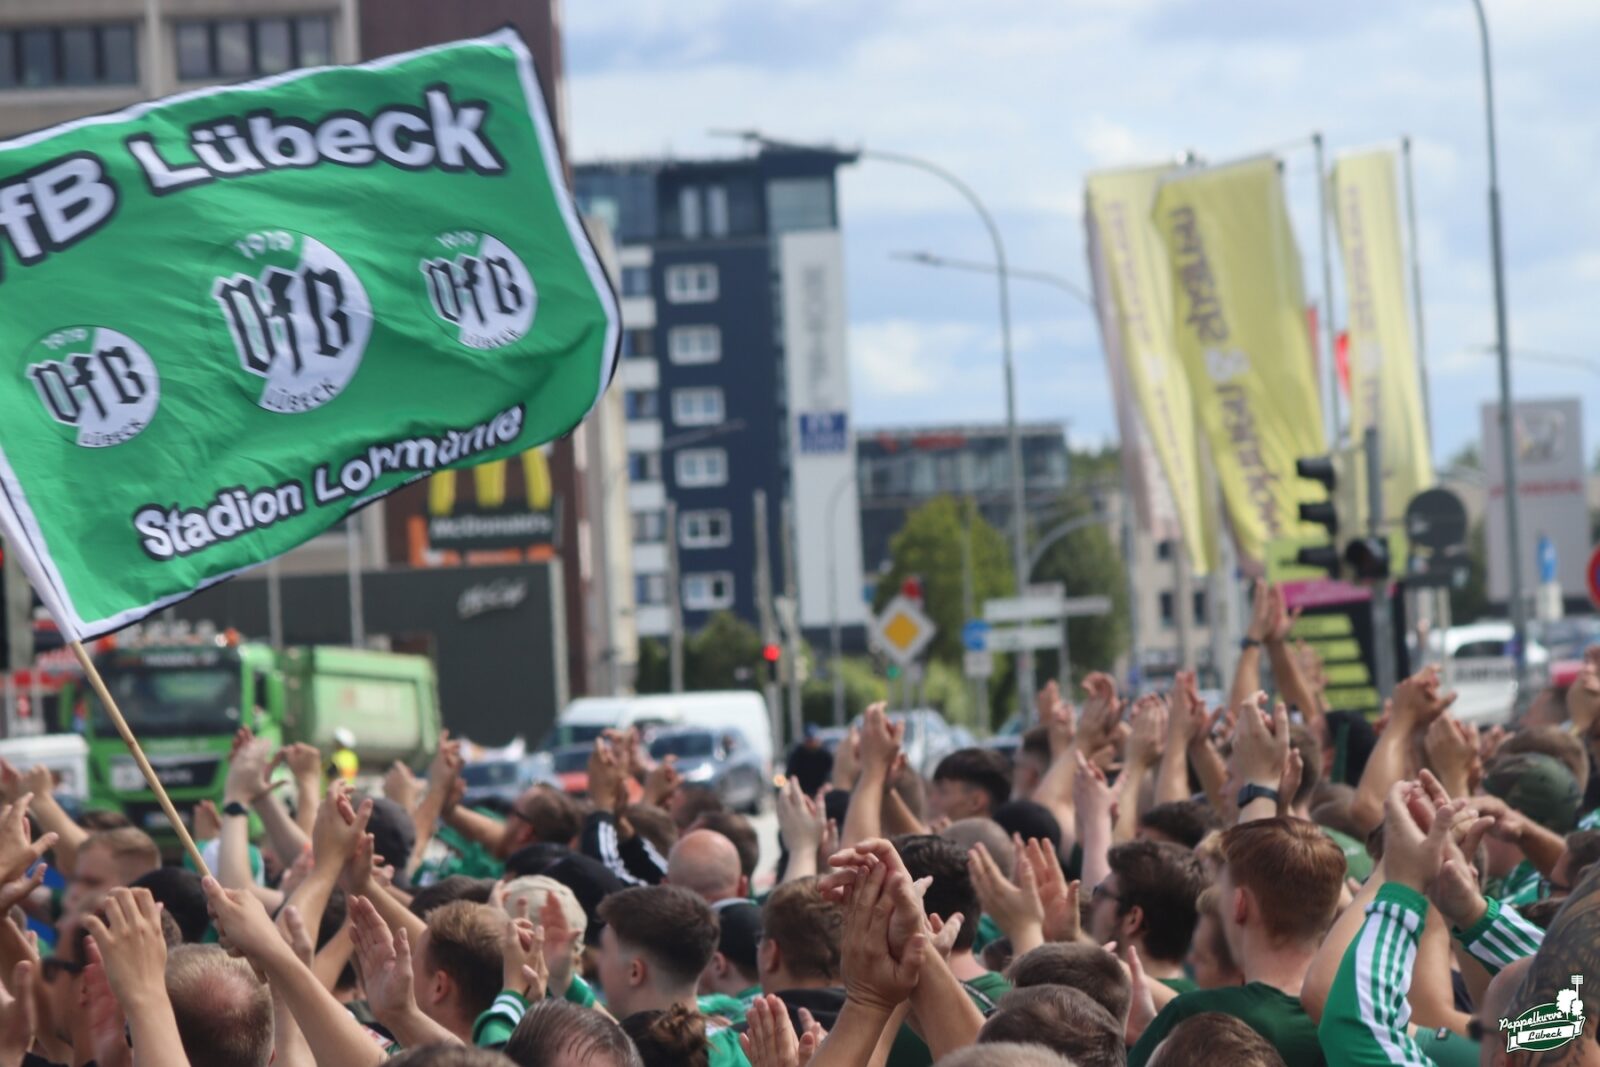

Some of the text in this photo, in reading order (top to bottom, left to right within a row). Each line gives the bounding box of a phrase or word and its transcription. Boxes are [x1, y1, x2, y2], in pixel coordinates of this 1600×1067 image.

[0, 84, 506, 265] fB Lübeck
[134, 480, 303, 559] Stadion
